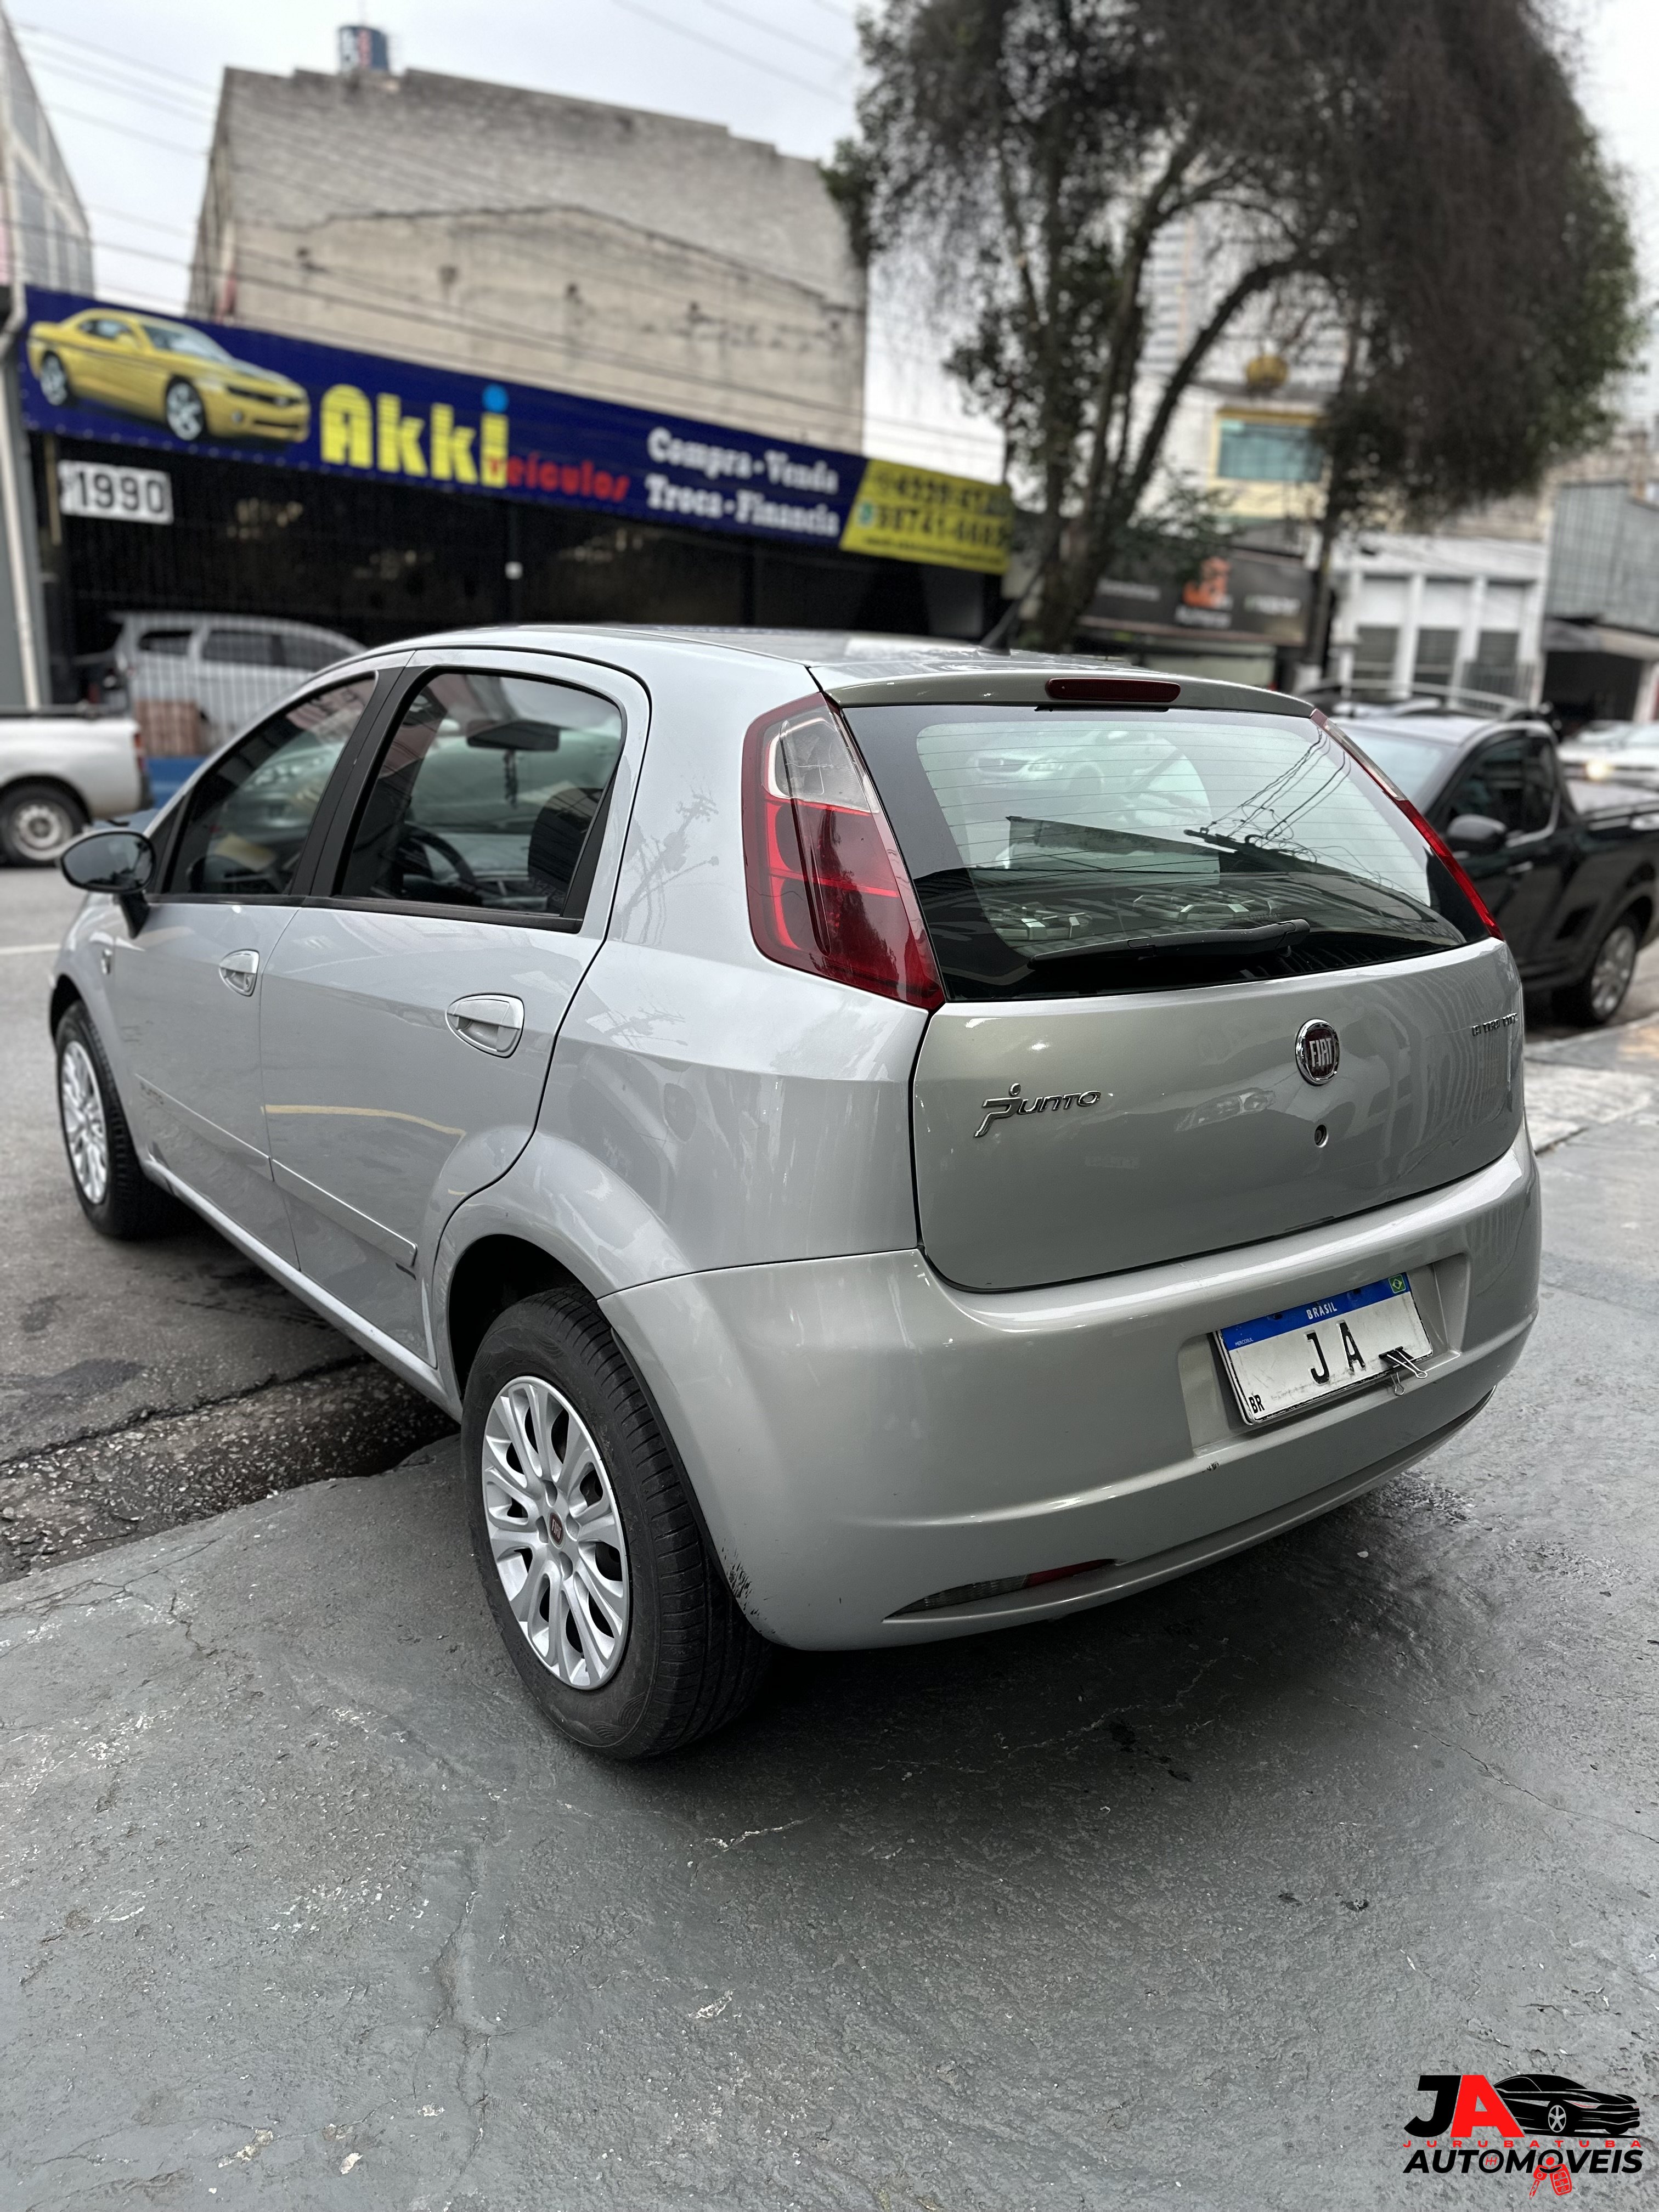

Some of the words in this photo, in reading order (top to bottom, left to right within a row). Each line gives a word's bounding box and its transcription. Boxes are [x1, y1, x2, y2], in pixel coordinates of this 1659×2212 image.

[320, 383, 510, 489] Akki
[78, 471, 166, 514] 1990
[1309, 1037, 1333, 1068] FIAT
[1306, 1302, 1338, 1320] BRASIL
[1248, 1394, 1266, 1414] BR
[551, 1518, 562, 1540] FIAT
